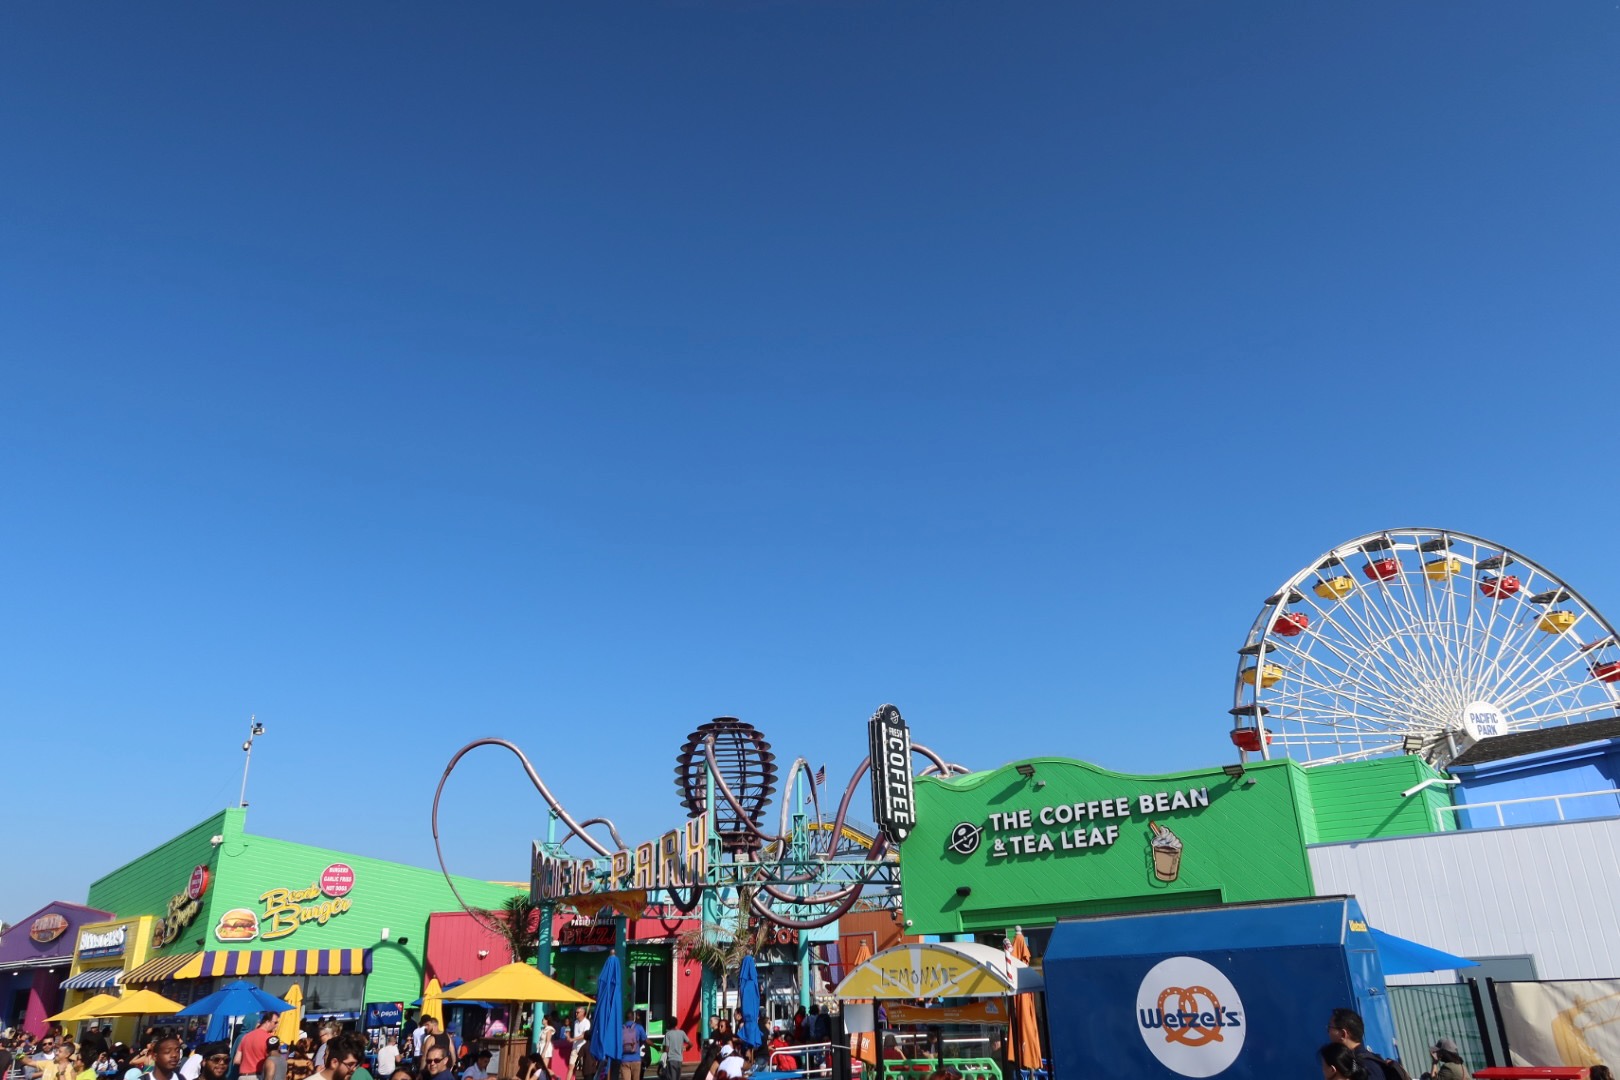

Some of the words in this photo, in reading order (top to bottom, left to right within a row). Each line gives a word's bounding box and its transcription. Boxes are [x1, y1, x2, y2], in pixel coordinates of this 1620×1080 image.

[1469, 712, 1499, 723] PACIFIC
[1477, 724, 1498, 735] PARK
[889, 738, 909, 825] COFFEE
[989, 809, 1032, 831] THE
[1039, 797, 1131, 826] COFFEE
[1139, 787, 1209, 814] BEAN
[610, 811, 708, 892] PARK
[992, 839, 1008, 857] &
[1010, 833, 1054, 854] TEA
[1060, 825, 1119, 849] LEAF
[261, 896, 352, 939] Burger
[881, 966, 958, 988] LEMONADE
[380, 1009, 398, 1017] pepsi
[1140, 1006, 1241, 1028] Wetzel's
